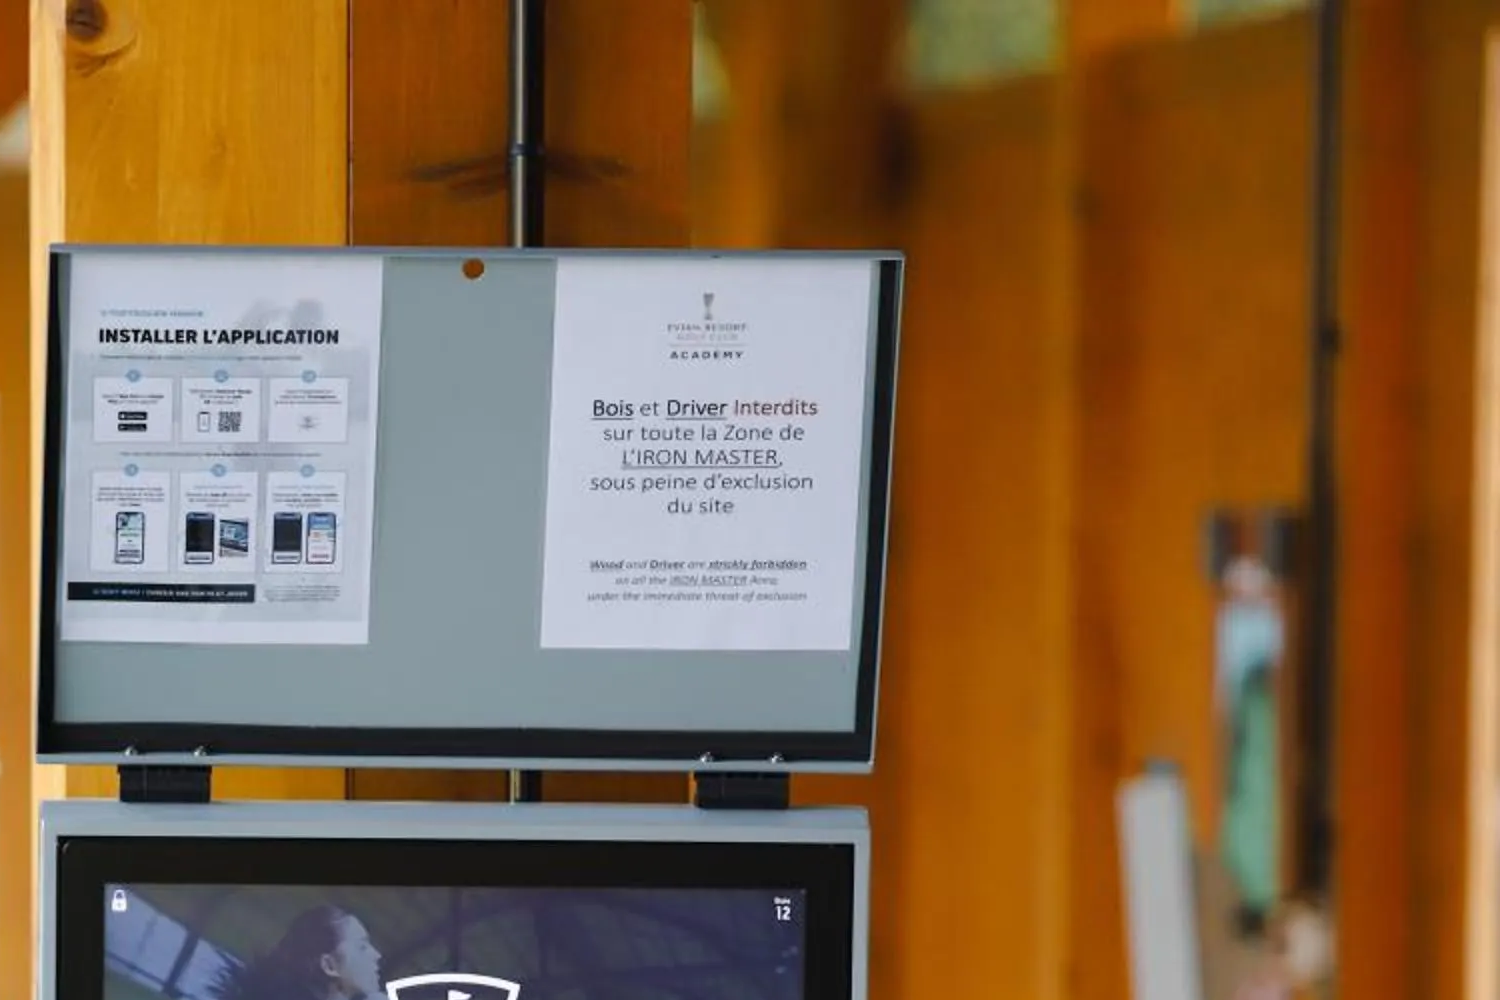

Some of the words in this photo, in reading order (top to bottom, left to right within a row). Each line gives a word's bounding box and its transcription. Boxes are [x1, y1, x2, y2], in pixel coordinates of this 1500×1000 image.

[99, 329, 198, 344] INSTALLER
[203, 329, 339, 345] L'APPLICATION
[669, 350, 744, 360] ACADEMY
[592, 399, 634, 418] Bois
[639, 401, 659, 417] et
[667, 399, 728, 418] Driver
[733, 398, 818, 417] Interdits
[602, 427, 634, 441] sur
[640, 425, 696, 441] toute
[700, 424, 718, 441] la
[723, 424, 774, 442] Zone
[779, 423, 806, 441] de
[621, 448, 688, 467] L'IRON
[694, 448, 783, 467] MASTER,
[590, 476, 636, 491] sous
[641, 475, 697, 493] peine
[702, 473, 813, 491] d'exclusion
[666, 497, 693, 514] du
[698, 498, 735, 514] site
[649, 559, 685, 569] Driver
[775, 905, 792, 921] 12
